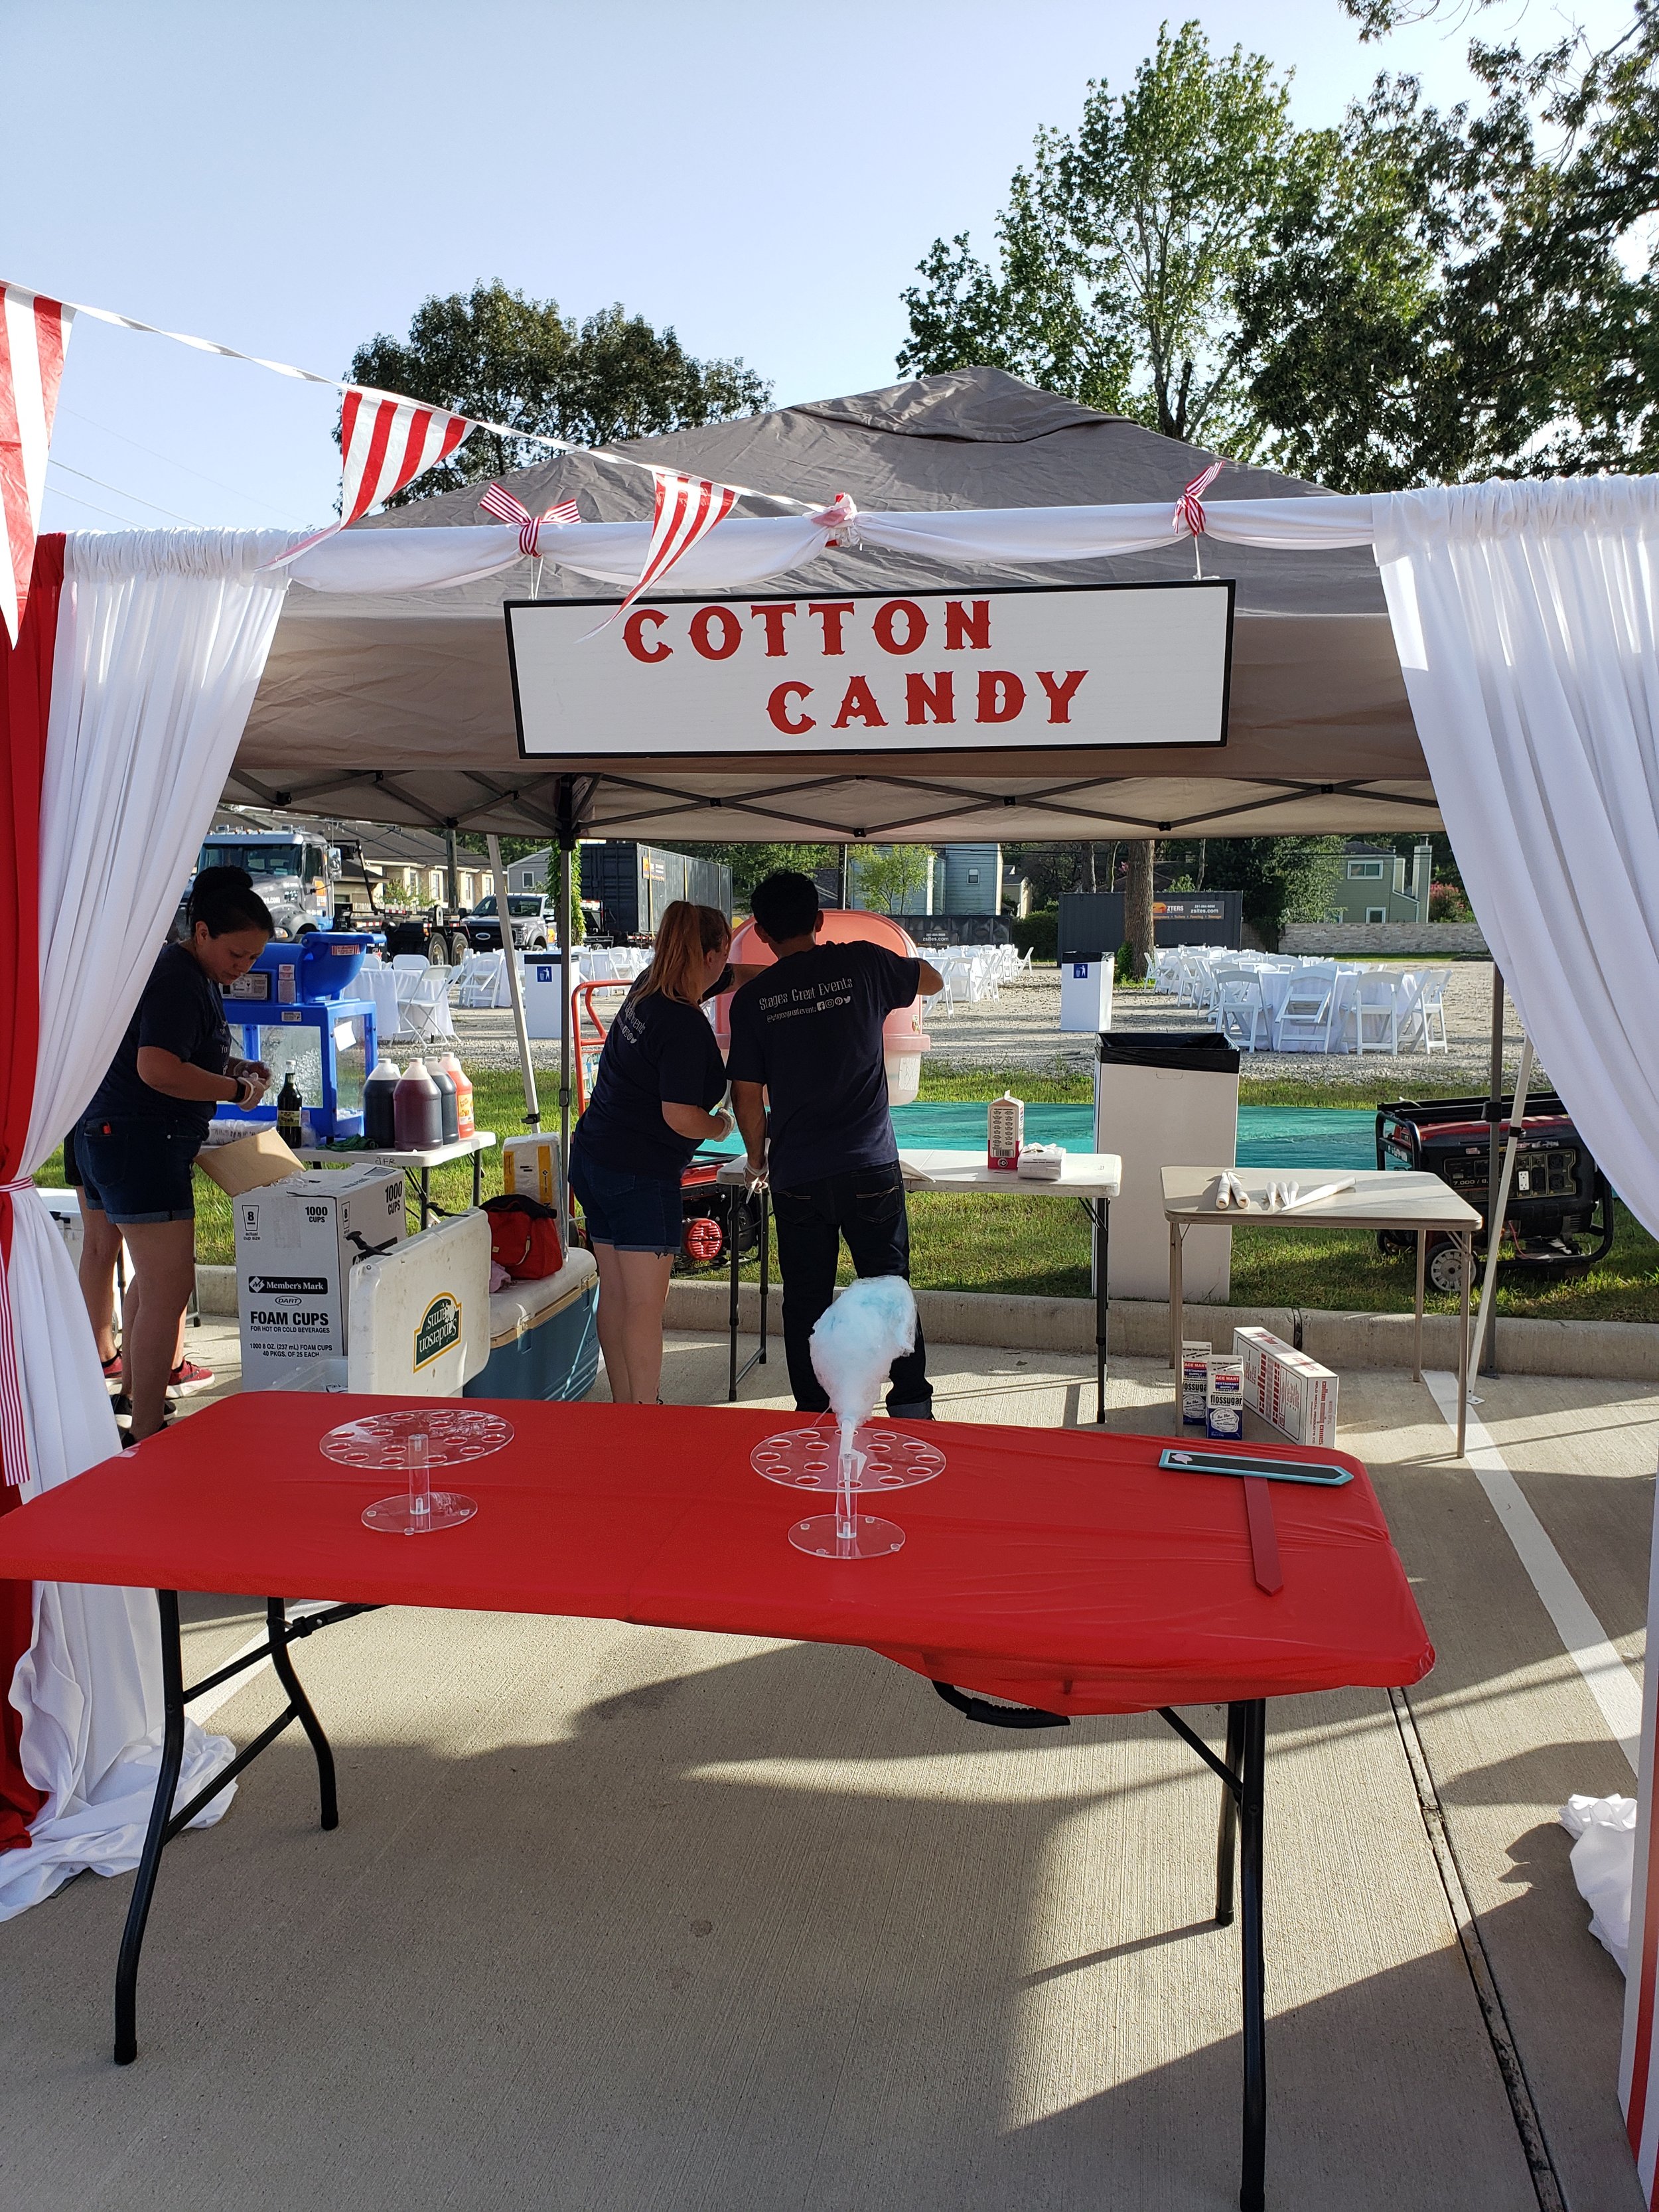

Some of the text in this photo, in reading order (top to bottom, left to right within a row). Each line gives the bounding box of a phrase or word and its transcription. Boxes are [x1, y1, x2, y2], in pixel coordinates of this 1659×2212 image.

[622, 599, 992, 664] COTTON
[766, 670, 1088, 735] CANDY
[759, 978, 853, 1011] Stages Great Events
[385, 1181, 403, 1203] 1000
[305, 1206, 328, 1216] 1000
[344, 1209, 348, 1219] 8
[388, 1200, 401, 1215] CUPS
[248, 1211, 254, 1221] 8
[250, 1311, 328, 1326] FOAM CUPS
[419, 1318, 457, 1353] Sanderson
[1210, 1394, 1242, 1406] flossugar
